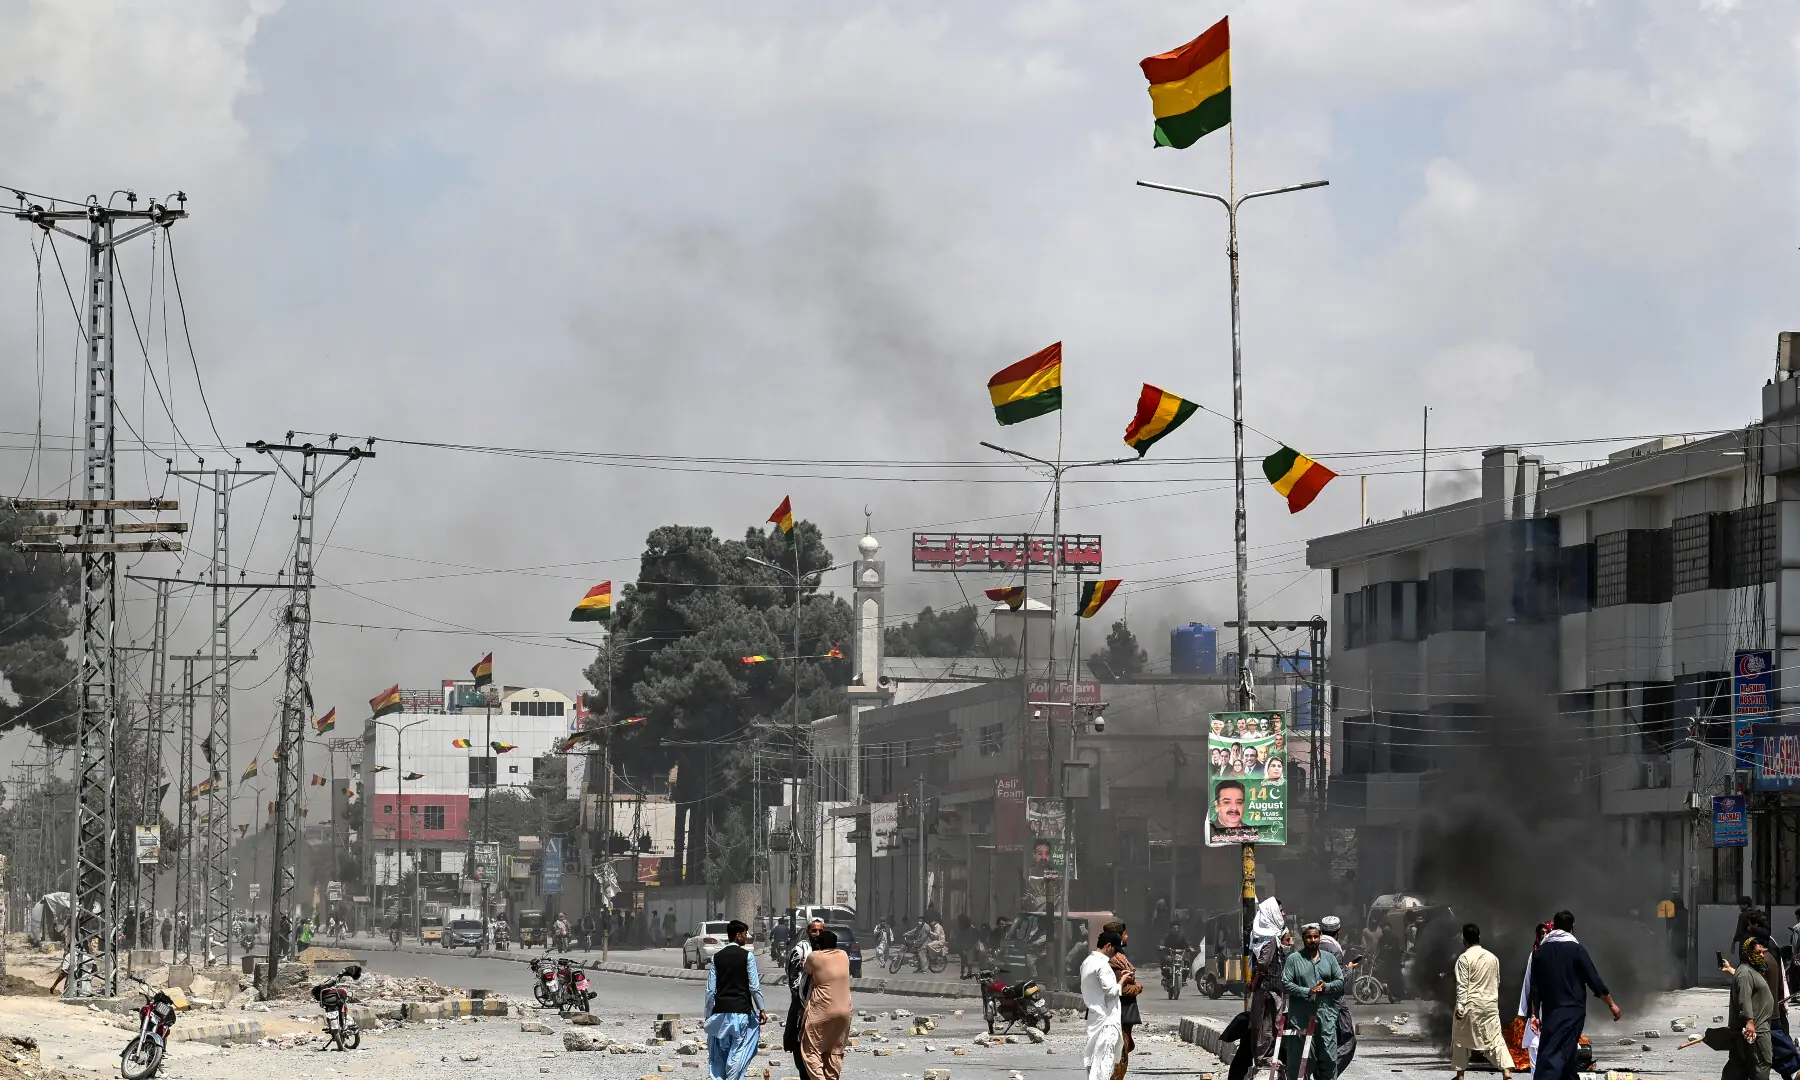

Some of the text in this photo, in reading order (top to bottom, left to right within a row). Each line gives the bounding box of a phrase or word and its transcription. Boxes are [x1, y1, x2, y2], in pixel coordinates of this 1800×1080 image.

[1739, 695, 1767, 705] HOSPITAL
[997, 789, 1024, 798] Foam
[1249, 787, 1267, 800] 14
[1248, 801, 1284, 811] August
[1248, 811, 1261, 821] 78
[1052, 852, 1073, 860] Augt
